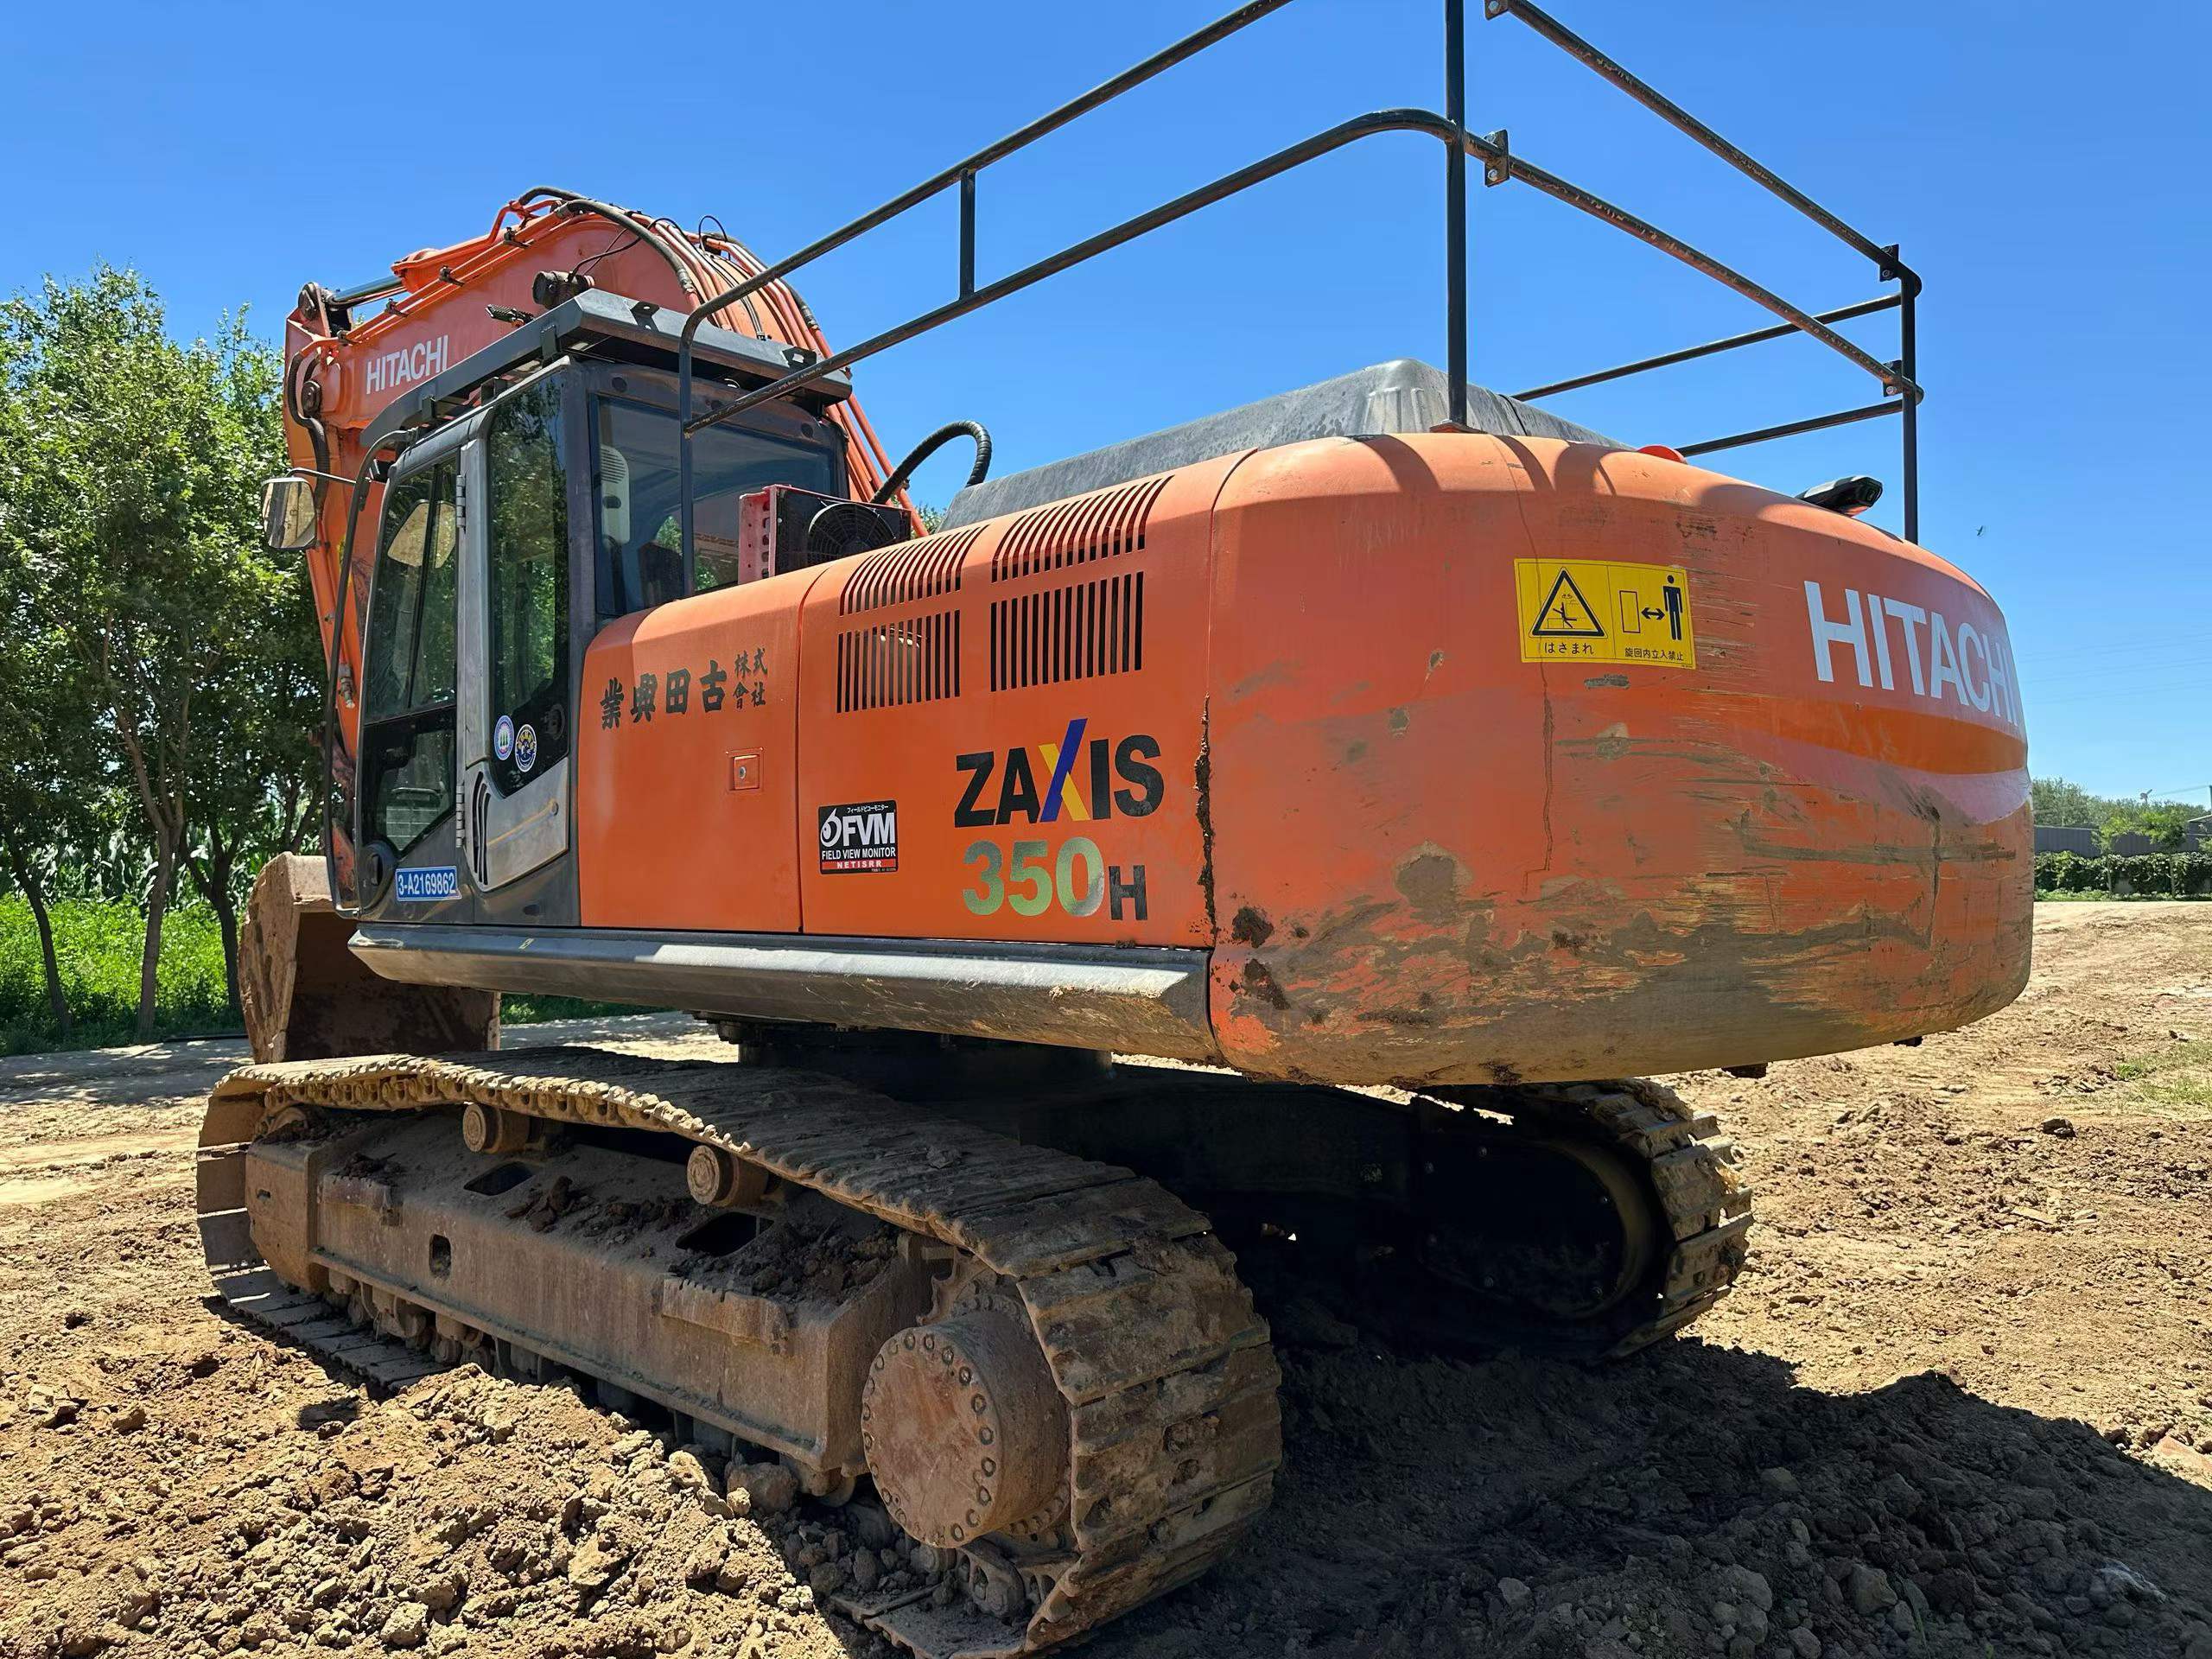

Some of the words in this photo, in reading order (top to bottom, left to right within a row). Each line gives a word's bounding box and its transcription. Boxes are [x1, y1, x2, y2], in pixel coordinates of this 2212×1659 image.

[366, 334, 448, 394] HITACHI
[1544, 642, 1594, 655] はさまれ
[1624, 647, 1684, 661] 旋回内立入禁止
[1804, 580, 2018, 727] HITACHI
[954, 718, 1165, 828] ZAXIS
[842, 812, 896, 847] FVM
[822, 849, 842, 860] FIELD
[842, 849, 861, 859] VIEW
[862, 847, 896, 858] MONITOR
[398, 872, 456, 895] 3-A2169862
